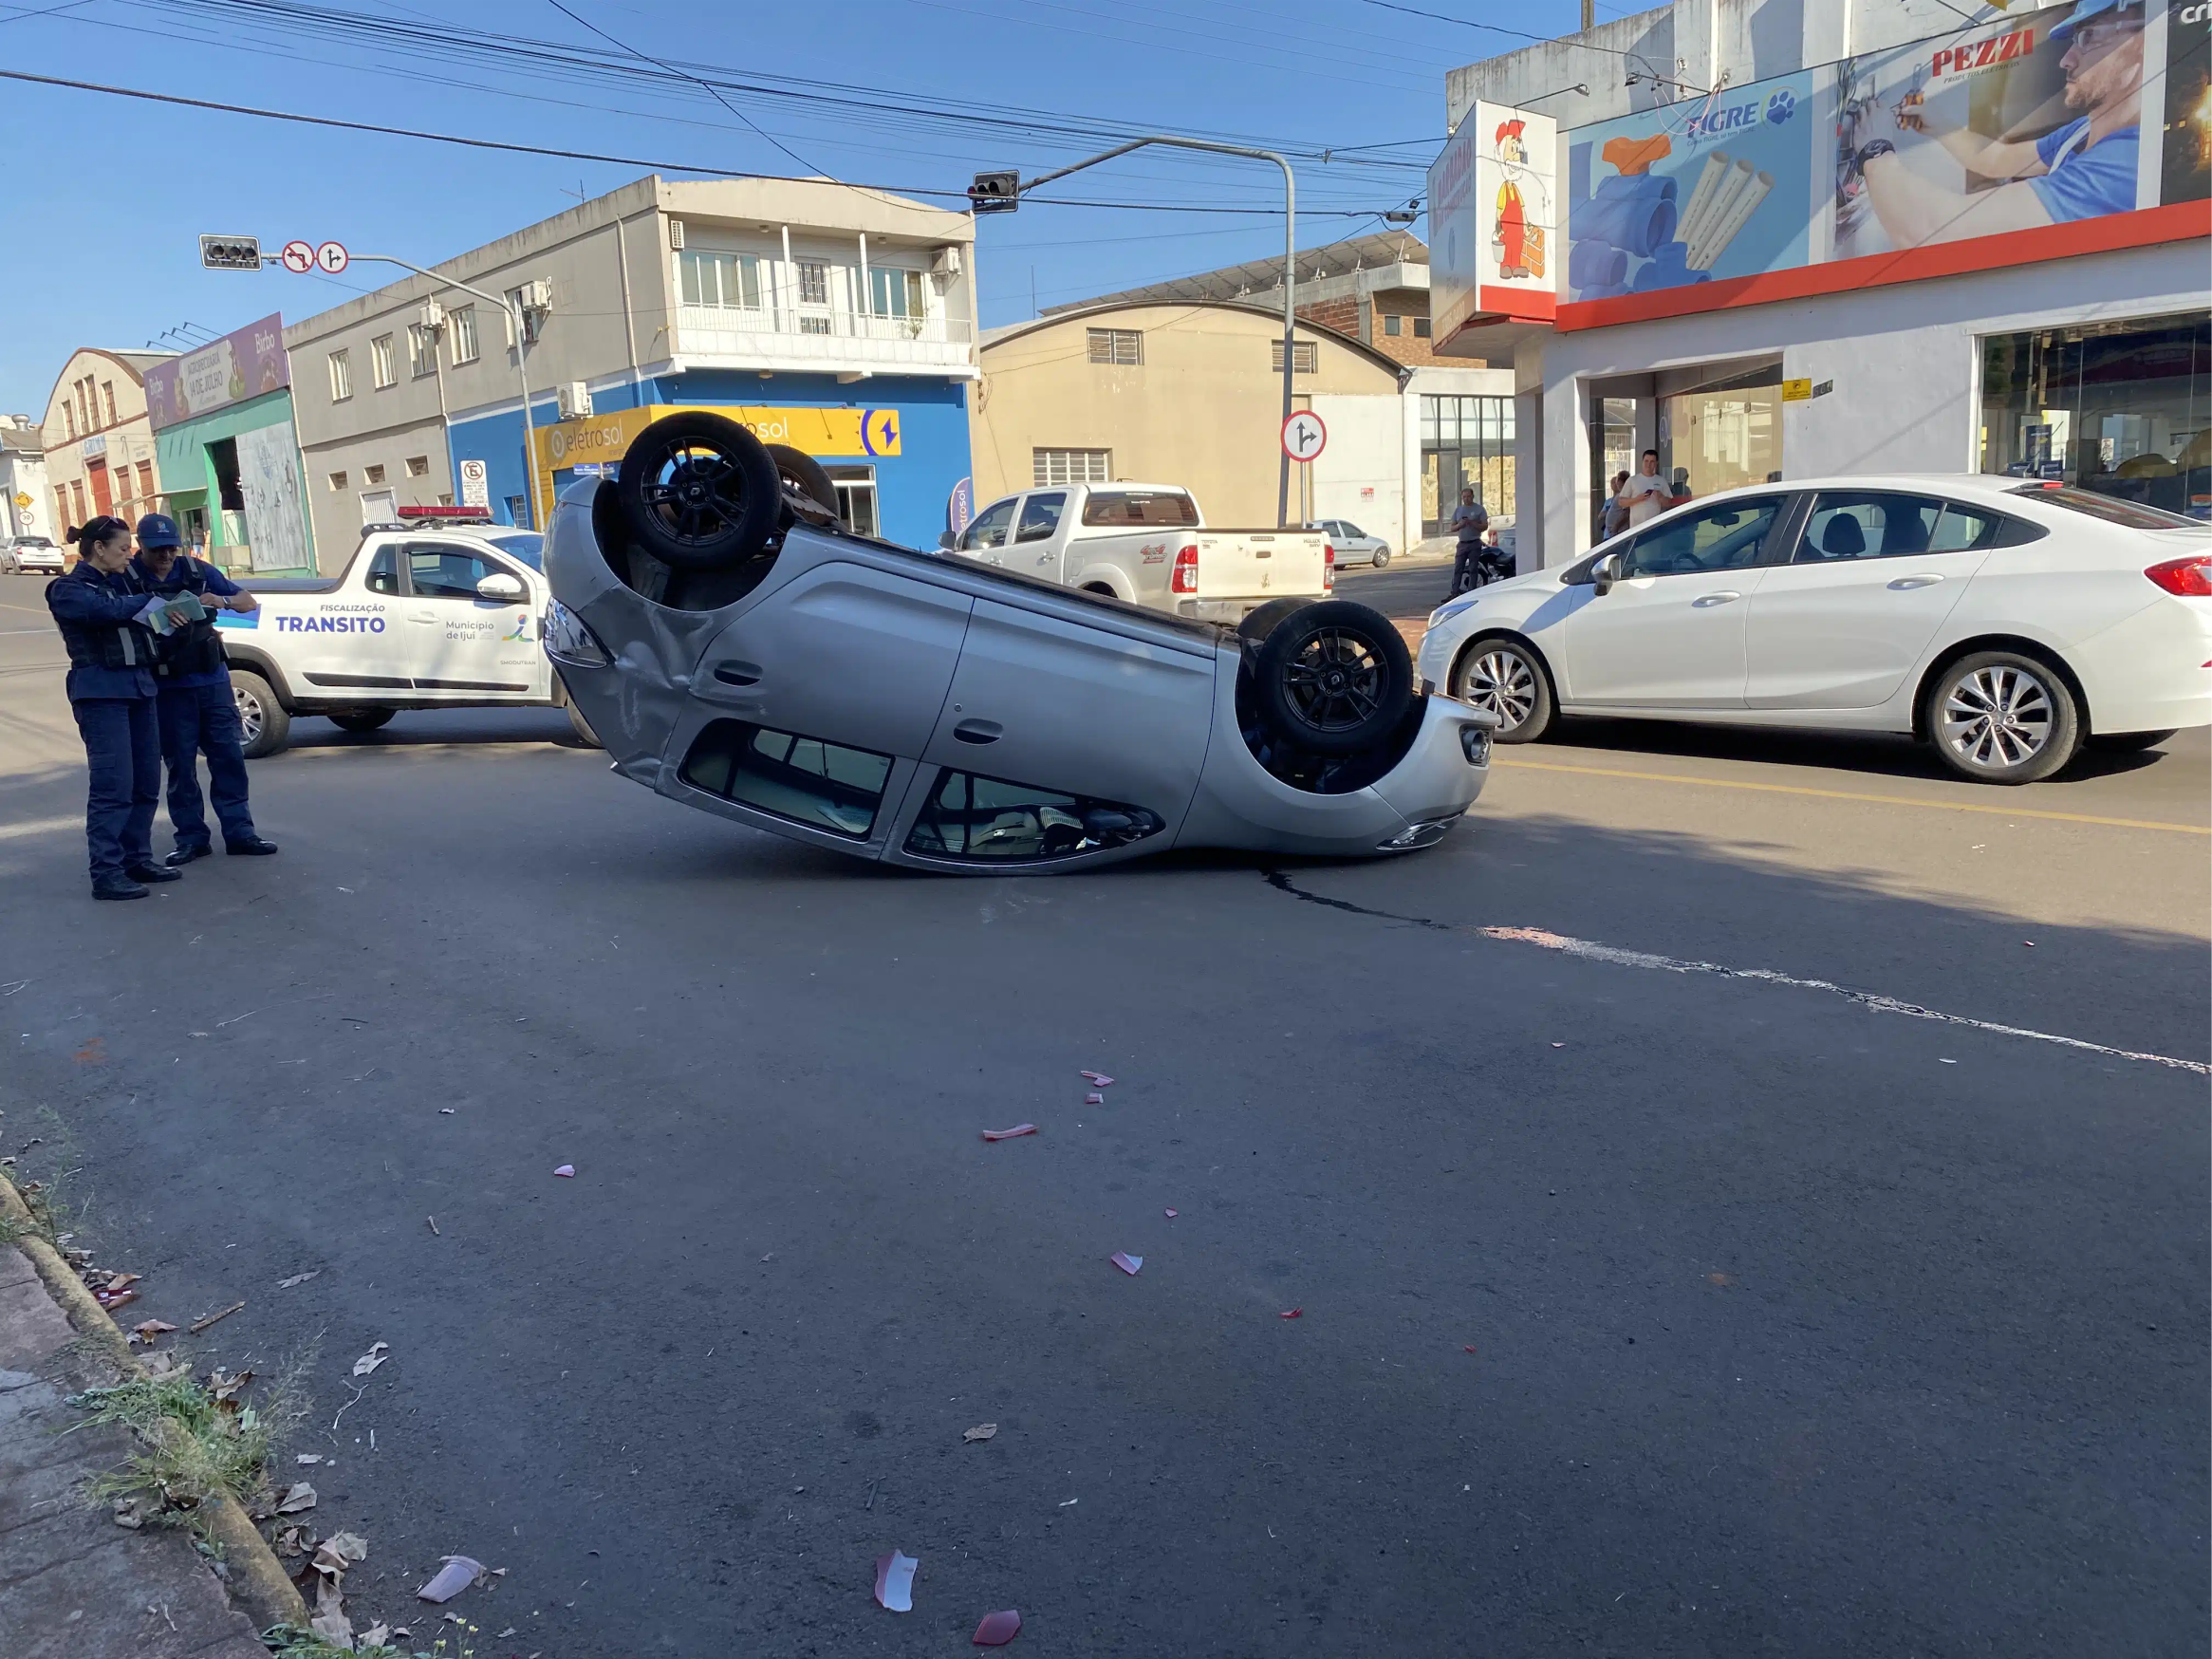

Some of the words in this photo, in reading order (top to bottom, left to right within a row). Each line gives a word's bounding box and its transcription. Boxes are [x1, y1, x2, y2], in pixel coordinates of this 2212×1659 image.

[1932, 28, 2036, 78] PEZZI
[1686, 102, 1759, 140] TIGRE
[254, 329, 275, 355] Birbo
[148, 375, 164, 396] Birbo
[204, 370, 223, 392] JULHO
[566, 418, 624, 453] eletrosol
[320, 603, 386, 614] FISCALIZAÇÃO
[275, 616, 386, 634] TRANSITO
[445, 620, 494, 631] Município
[446, 630, 459, 640] de
[460, 630, 475, 642] Ijuí
